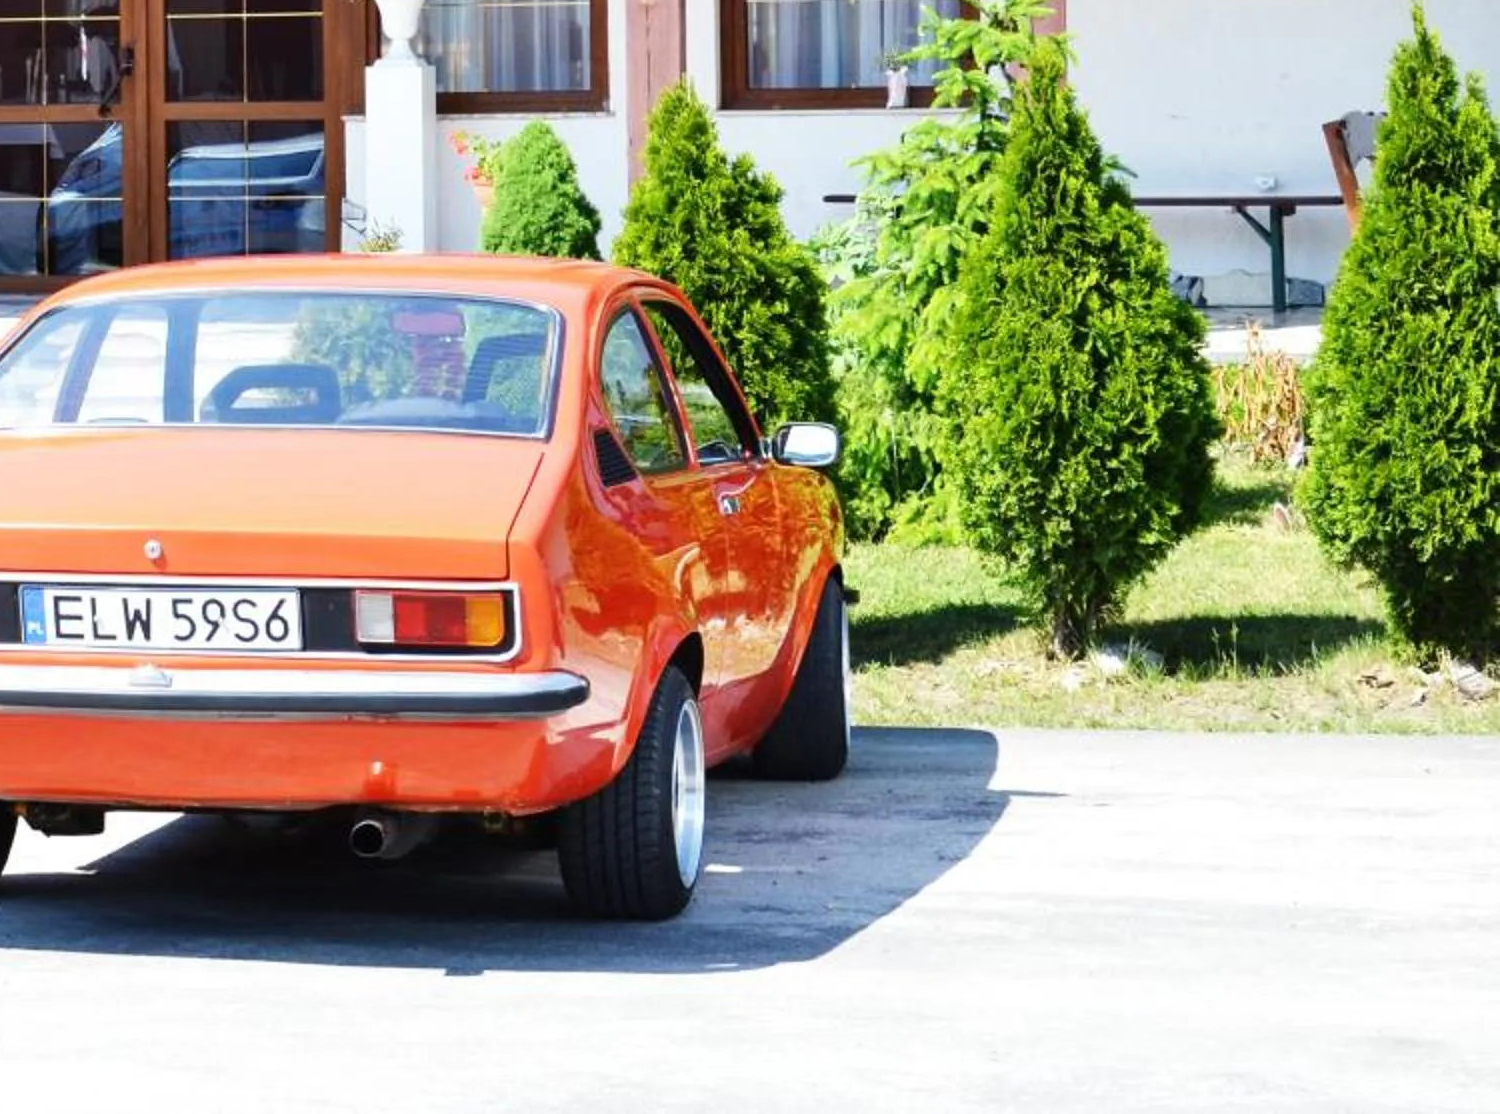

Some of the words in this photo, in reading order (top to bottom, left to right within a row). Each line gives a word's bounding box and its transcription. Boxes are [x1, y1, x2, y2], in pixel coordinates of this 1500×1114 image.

[27, 621, 44, 635] PL
[53, 595, 151, 641] ELW
[171, 597, 290, 642] 59S6
